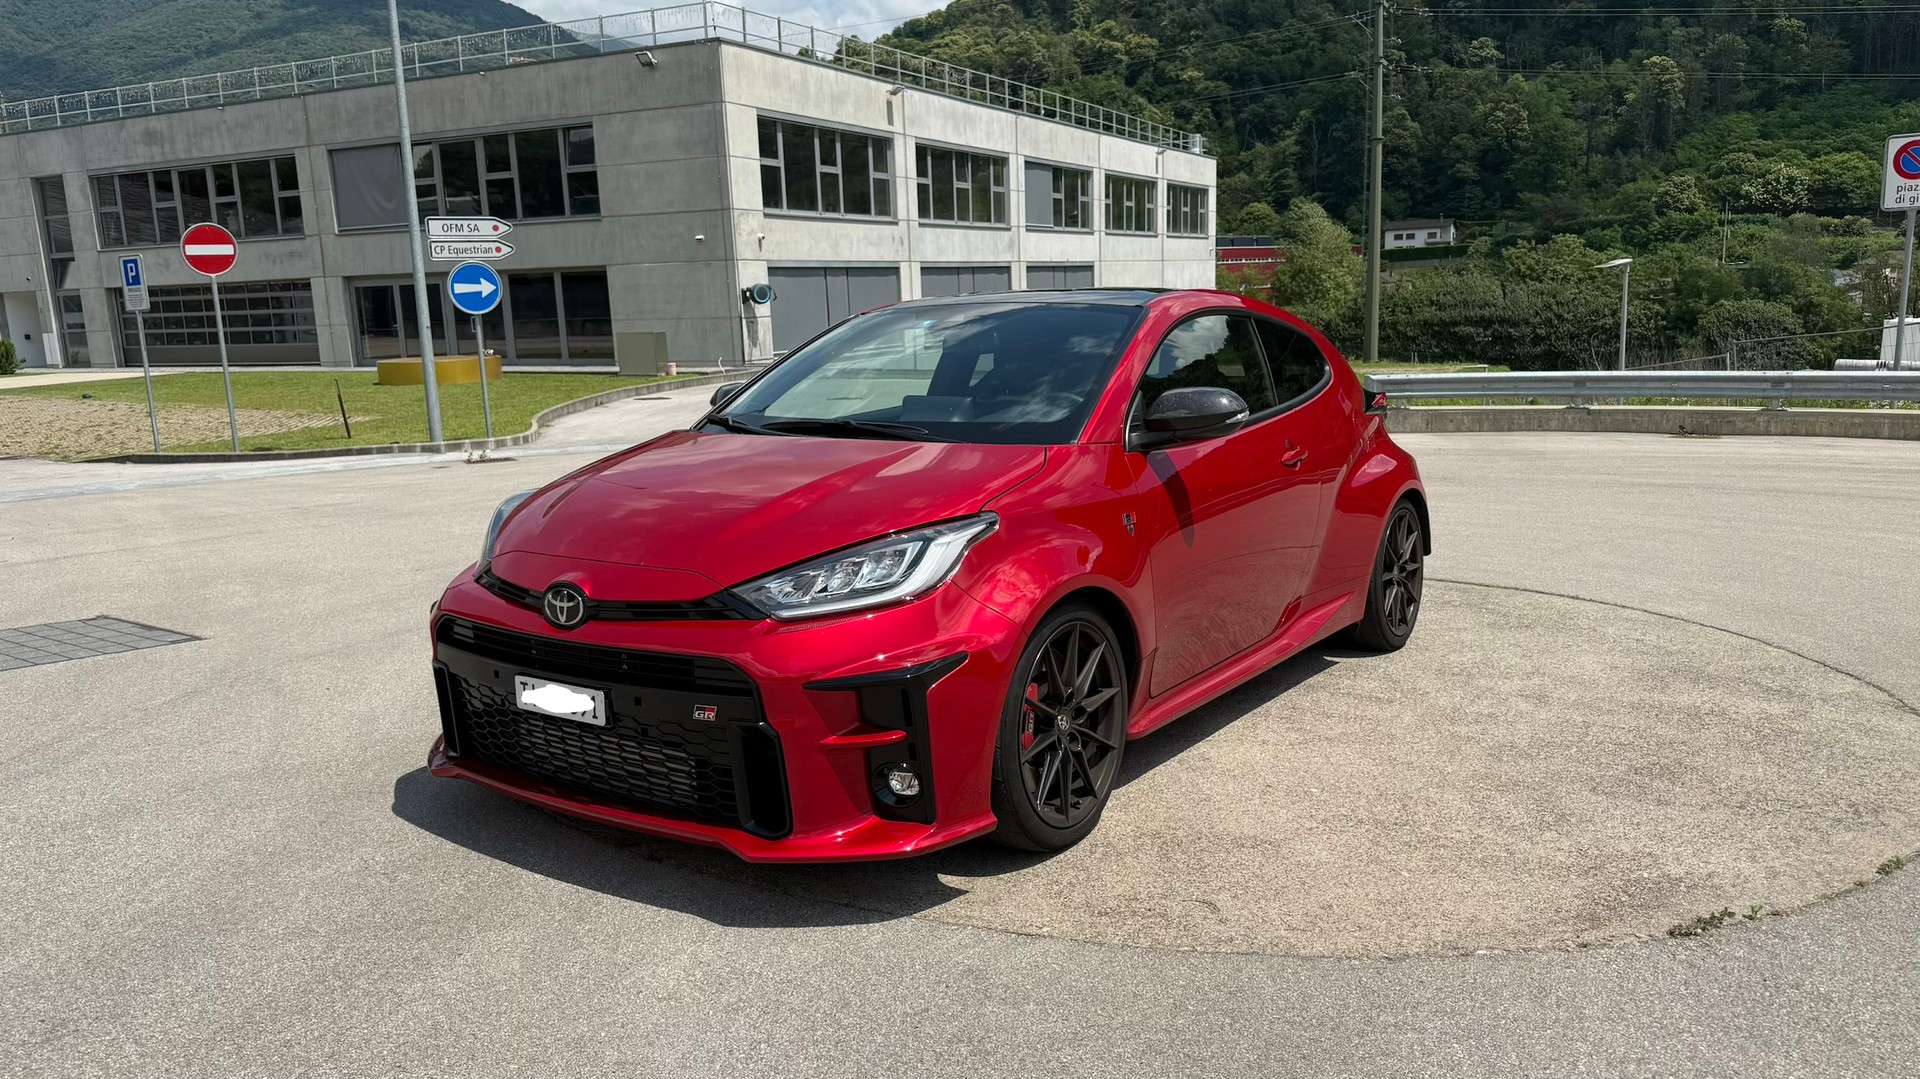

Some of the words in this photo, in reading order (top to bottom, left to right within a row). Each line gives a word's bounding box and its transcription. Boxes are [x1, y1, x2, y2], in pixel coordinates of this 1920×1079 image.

[1895, 193, 1906, 204] di
[1908, 192, 1919, 206] gi
[441, 223, 464, 233] OFM
[466, 223, 480, 233] SA
[434, 245, 446, 255] CP
[448, 244, 493, 257] Equestrian
[127, 263, 137, 283] P
[695, 709, 716, 720] GR
